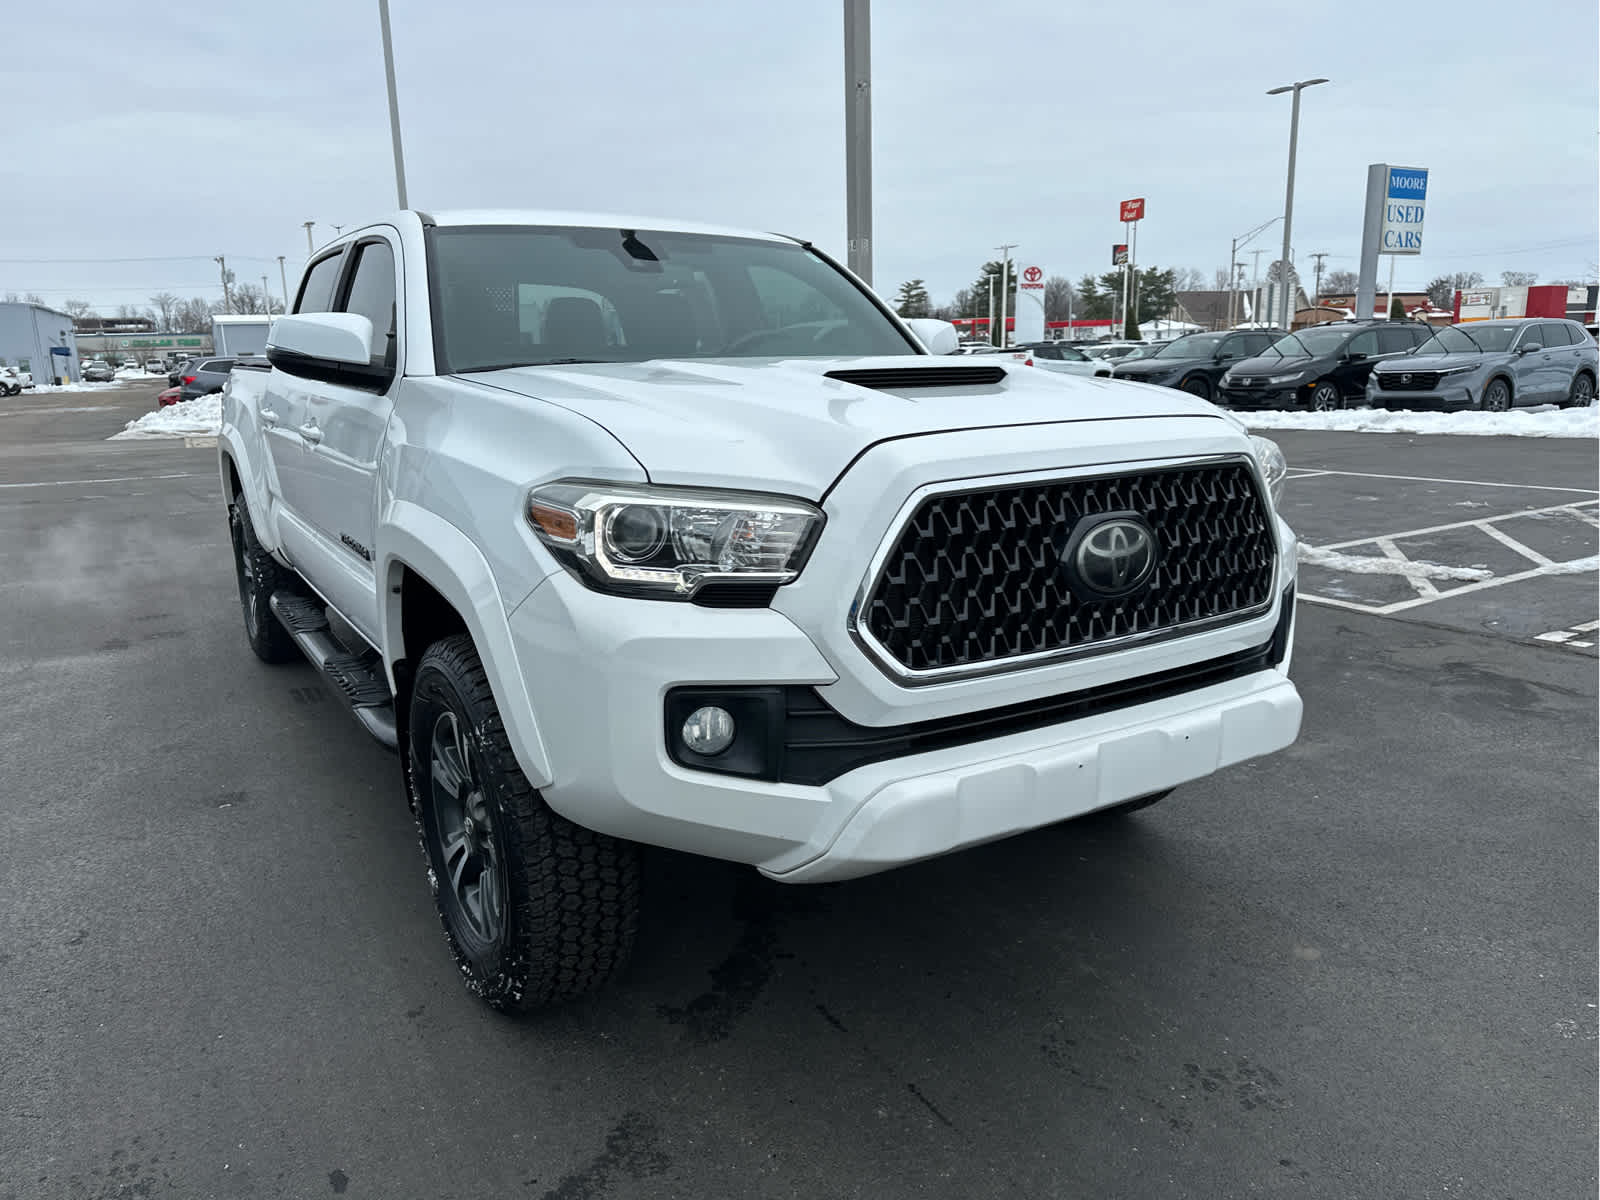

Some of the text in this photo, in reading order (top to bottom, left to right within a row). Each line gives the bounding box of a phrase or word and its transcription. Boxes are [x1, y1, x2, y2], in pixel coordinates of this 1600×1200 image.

[1391, 176, 1426, 190] MOORE
[1387, 204, 1424, 223] USED
[1384, 230, 1422, 248] CARS
